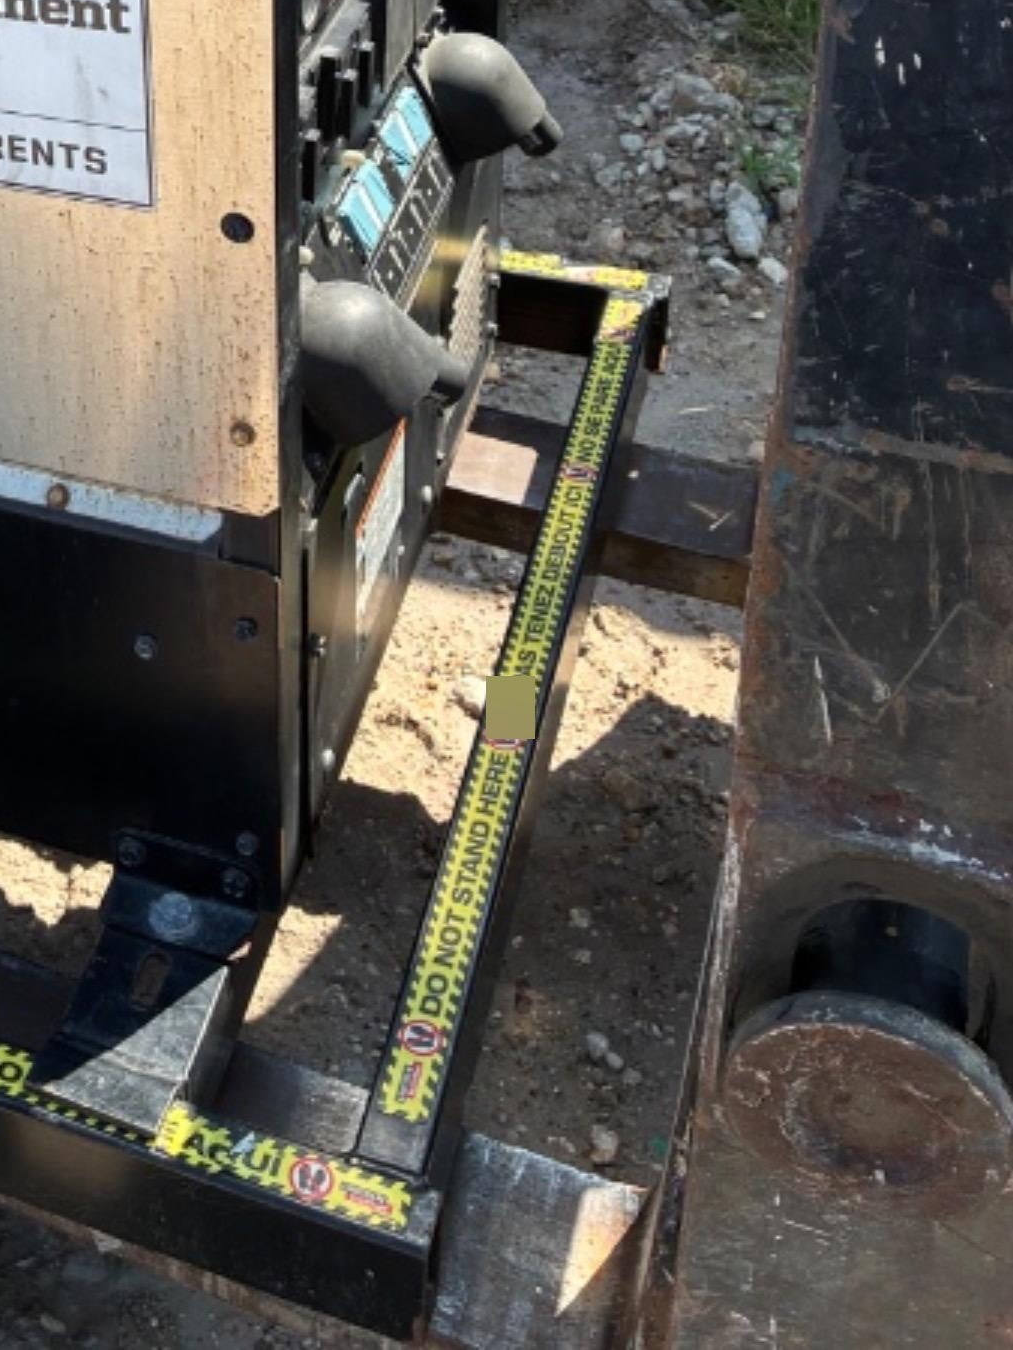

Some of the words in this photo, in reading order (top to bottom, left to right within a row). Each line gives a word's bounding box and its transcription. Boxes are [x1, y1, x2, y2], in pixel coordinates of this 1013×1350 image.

[542, 511, 577, 581] DEBOUT
[524, 584, 556, 643] TENEZ
[514, 650, 538, 677] AS
[418, 973, 450, 1016] DO
[434, 907, 467, 969] NOT
[452, 820, 491, 905] STAND
[476, 751, 510, 817] HERE
